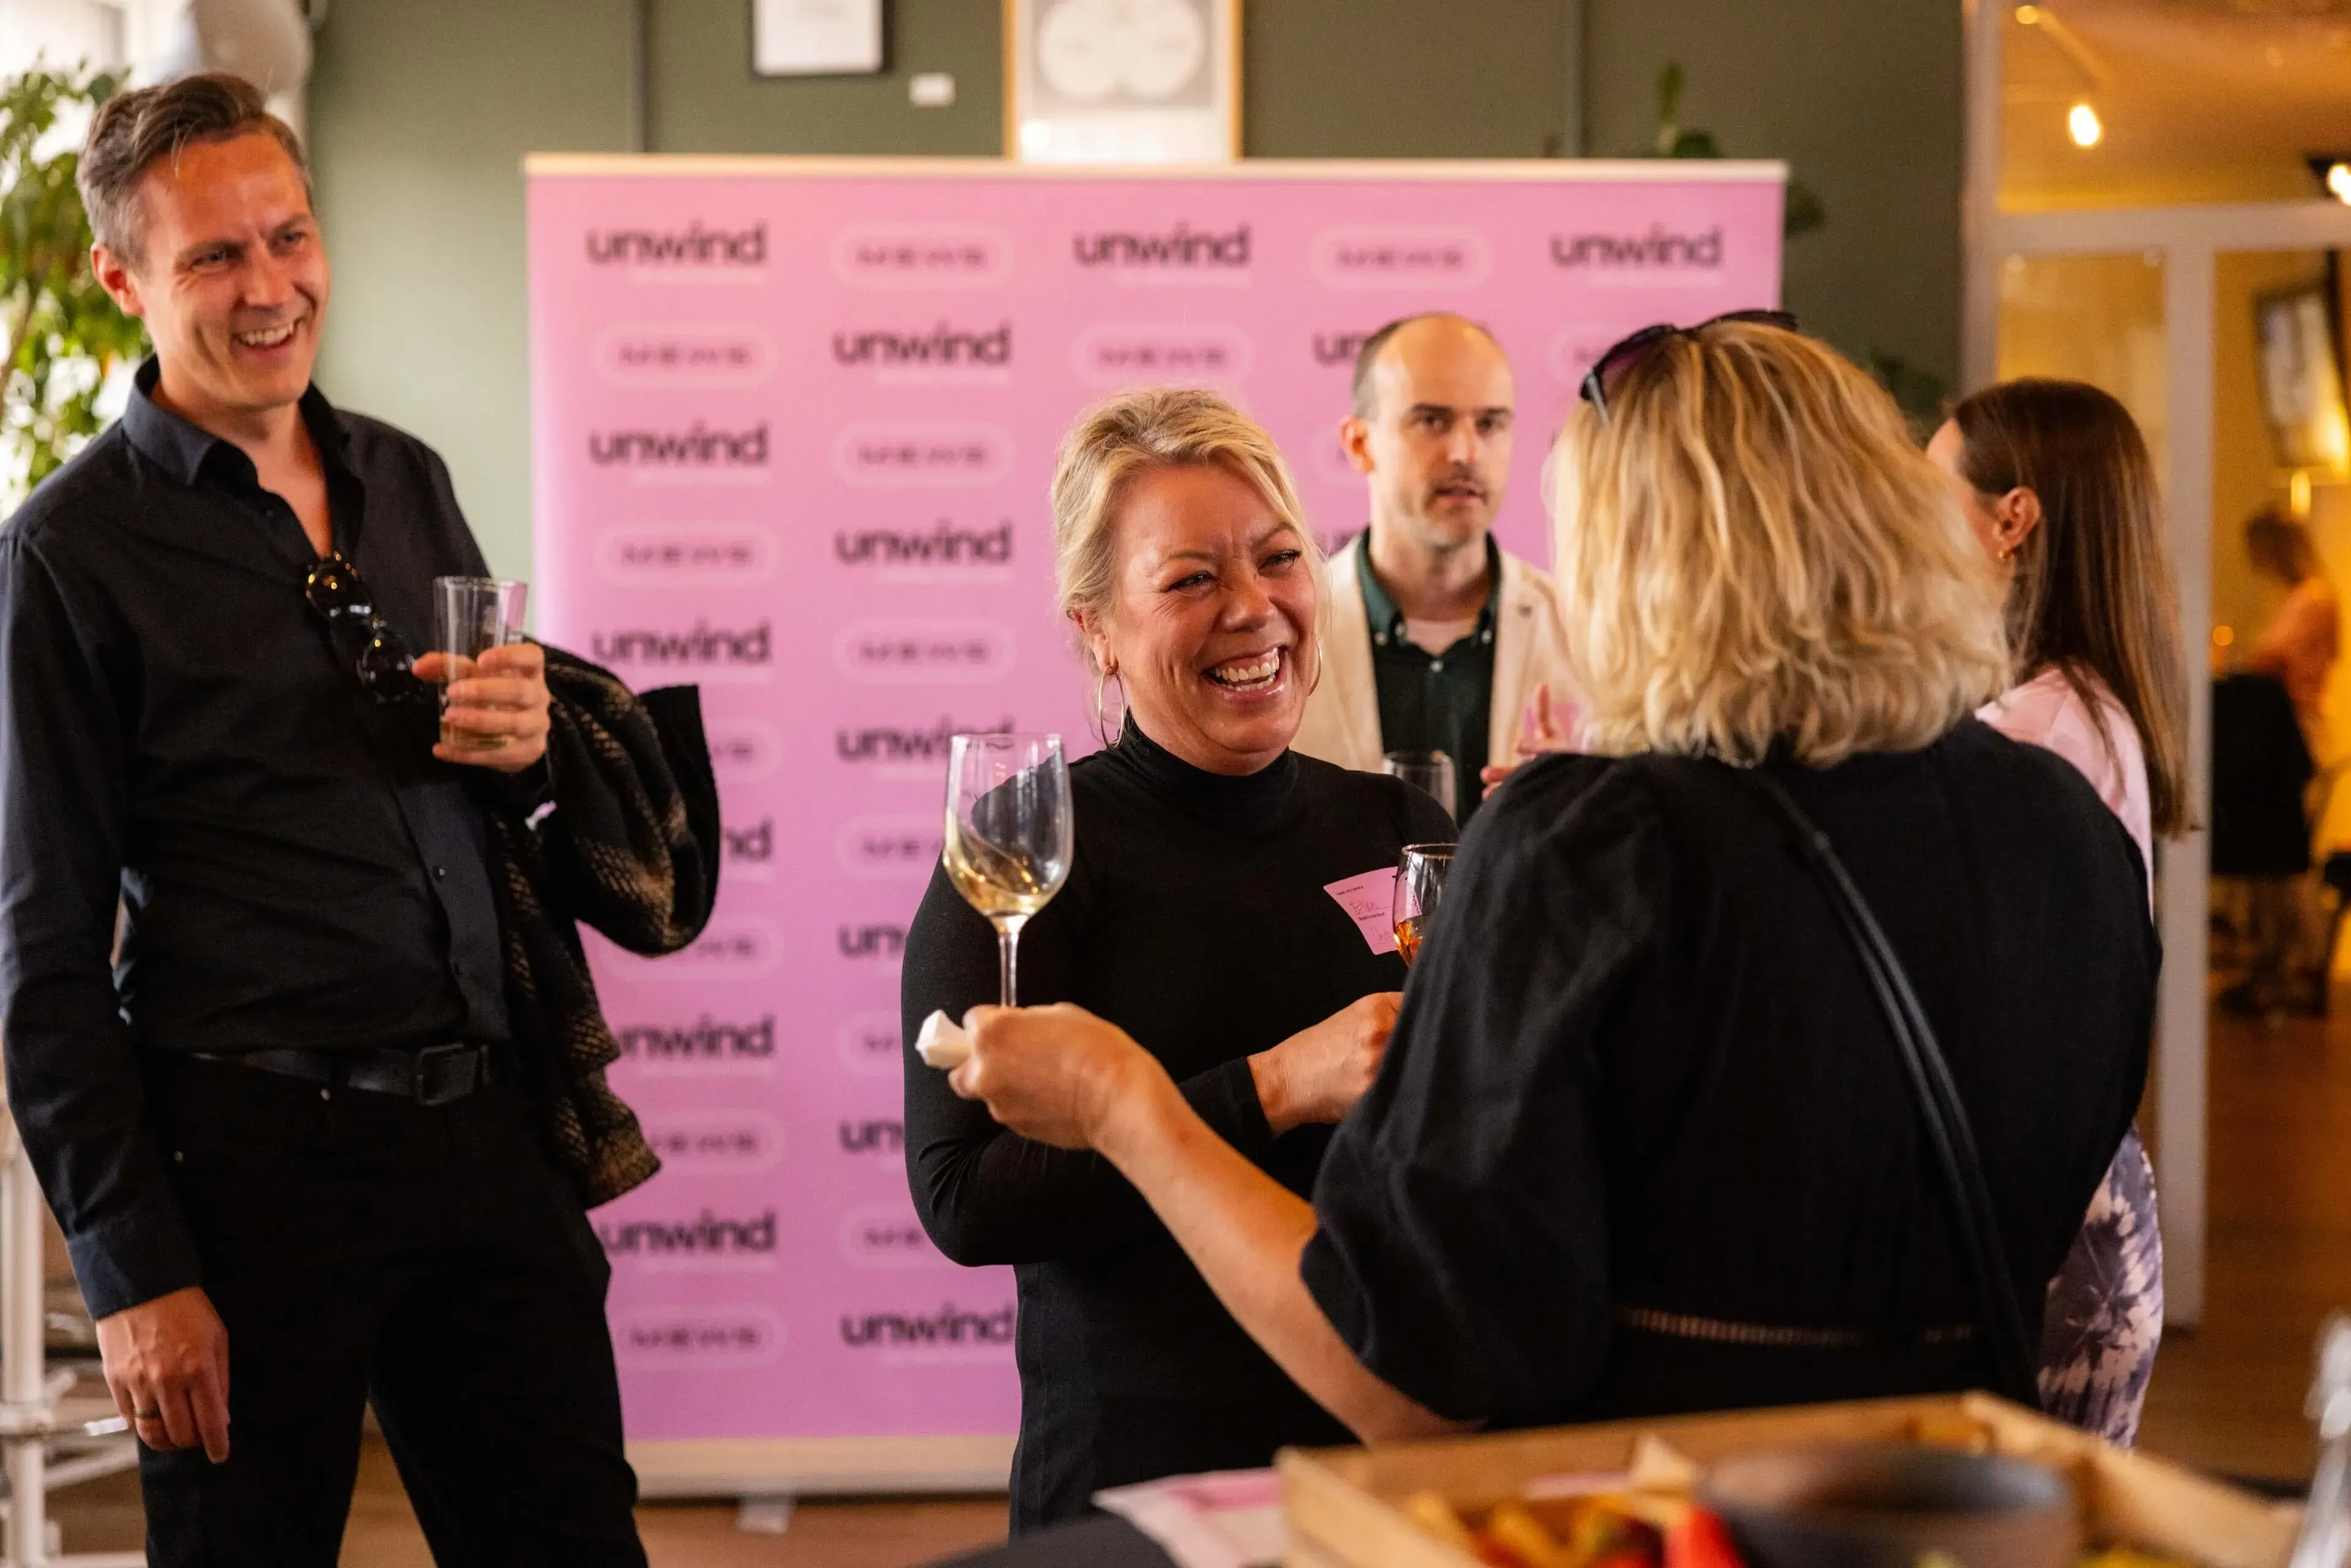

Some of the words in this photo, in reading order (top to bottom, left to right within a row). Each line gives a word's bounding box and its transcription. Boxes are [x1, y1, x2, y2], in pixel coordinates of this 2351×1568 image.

[586, 220, 767, 265] unwind
[1073, 223, 1251, 267] unwind
[1550, 224, 1723, 268] unwind
[833, 321, 1011, 366] unwind
[590, 421, 770, 465] unwind
[834, 520, 1013, 565] unwind
[590, 618, 771, 663] unwind
[599, 1209, 776, 1252] unwind
[839, 1302, 1016, 1347] unwind
